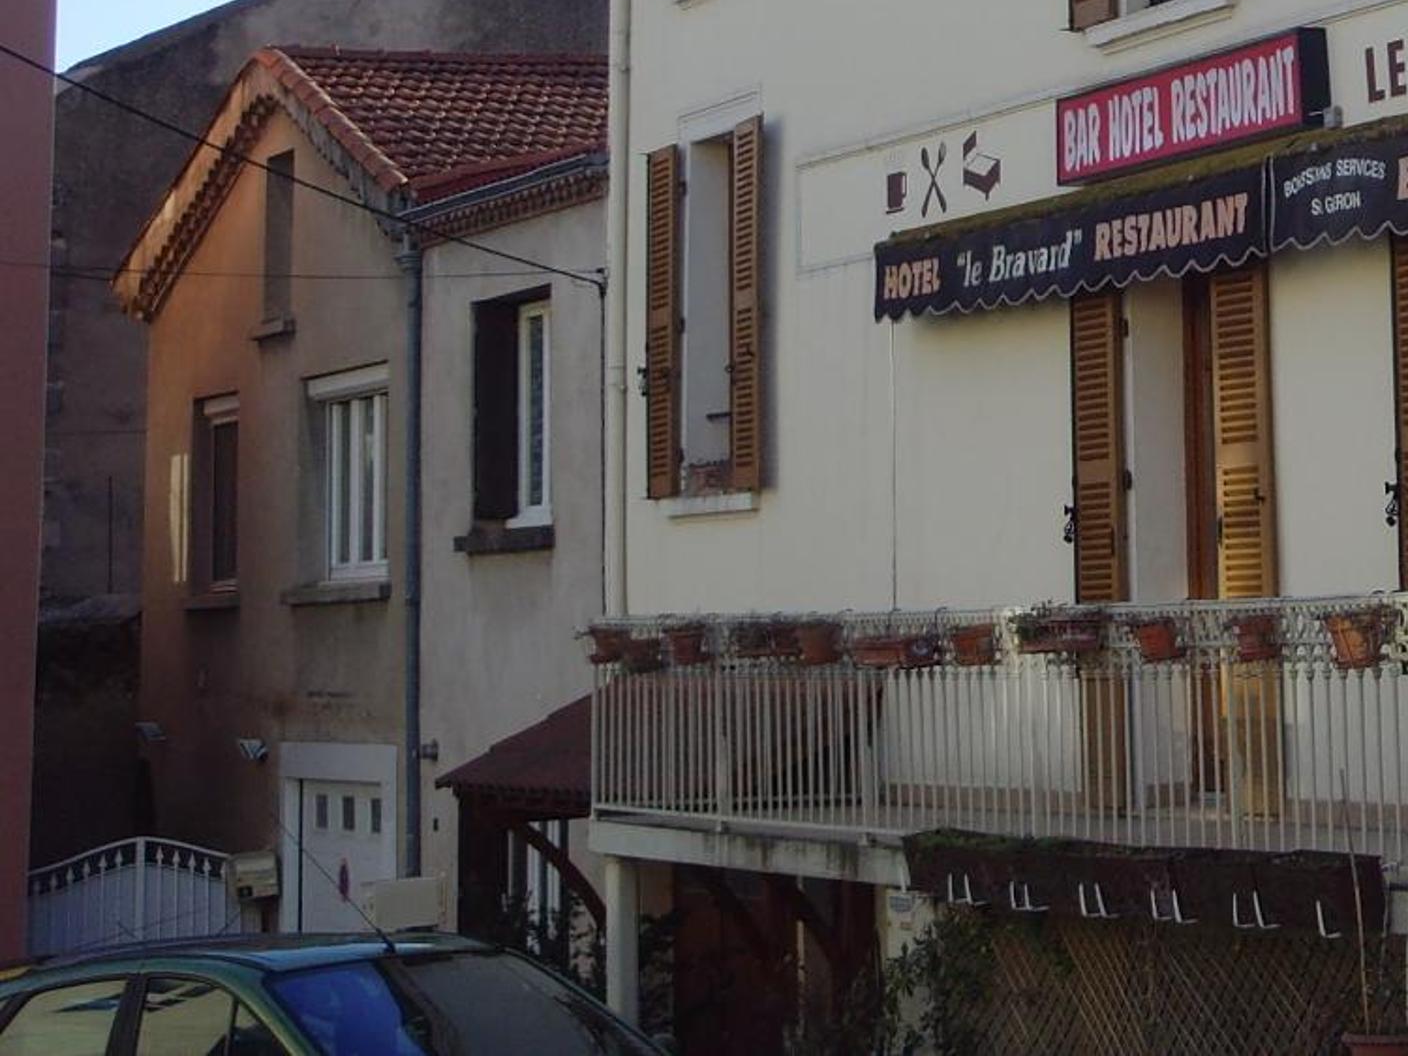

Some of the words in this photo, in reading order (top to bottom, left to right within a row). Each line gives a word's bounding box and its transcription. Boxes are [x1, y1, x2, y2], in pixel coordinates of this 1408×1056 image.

[1064, 103, 1101, 172] BAR
[1109, 86, 1164, 161] HOTEL
[1171, 46, 1295, 144] RESTAURANT
[1365, 39, 1408, 104] LE
[1336, 158, 1386, 180] SERVICES
[883, 257, 941, 300] HOTEL
[1094, 192, 1248, 262] RESTAURANT
